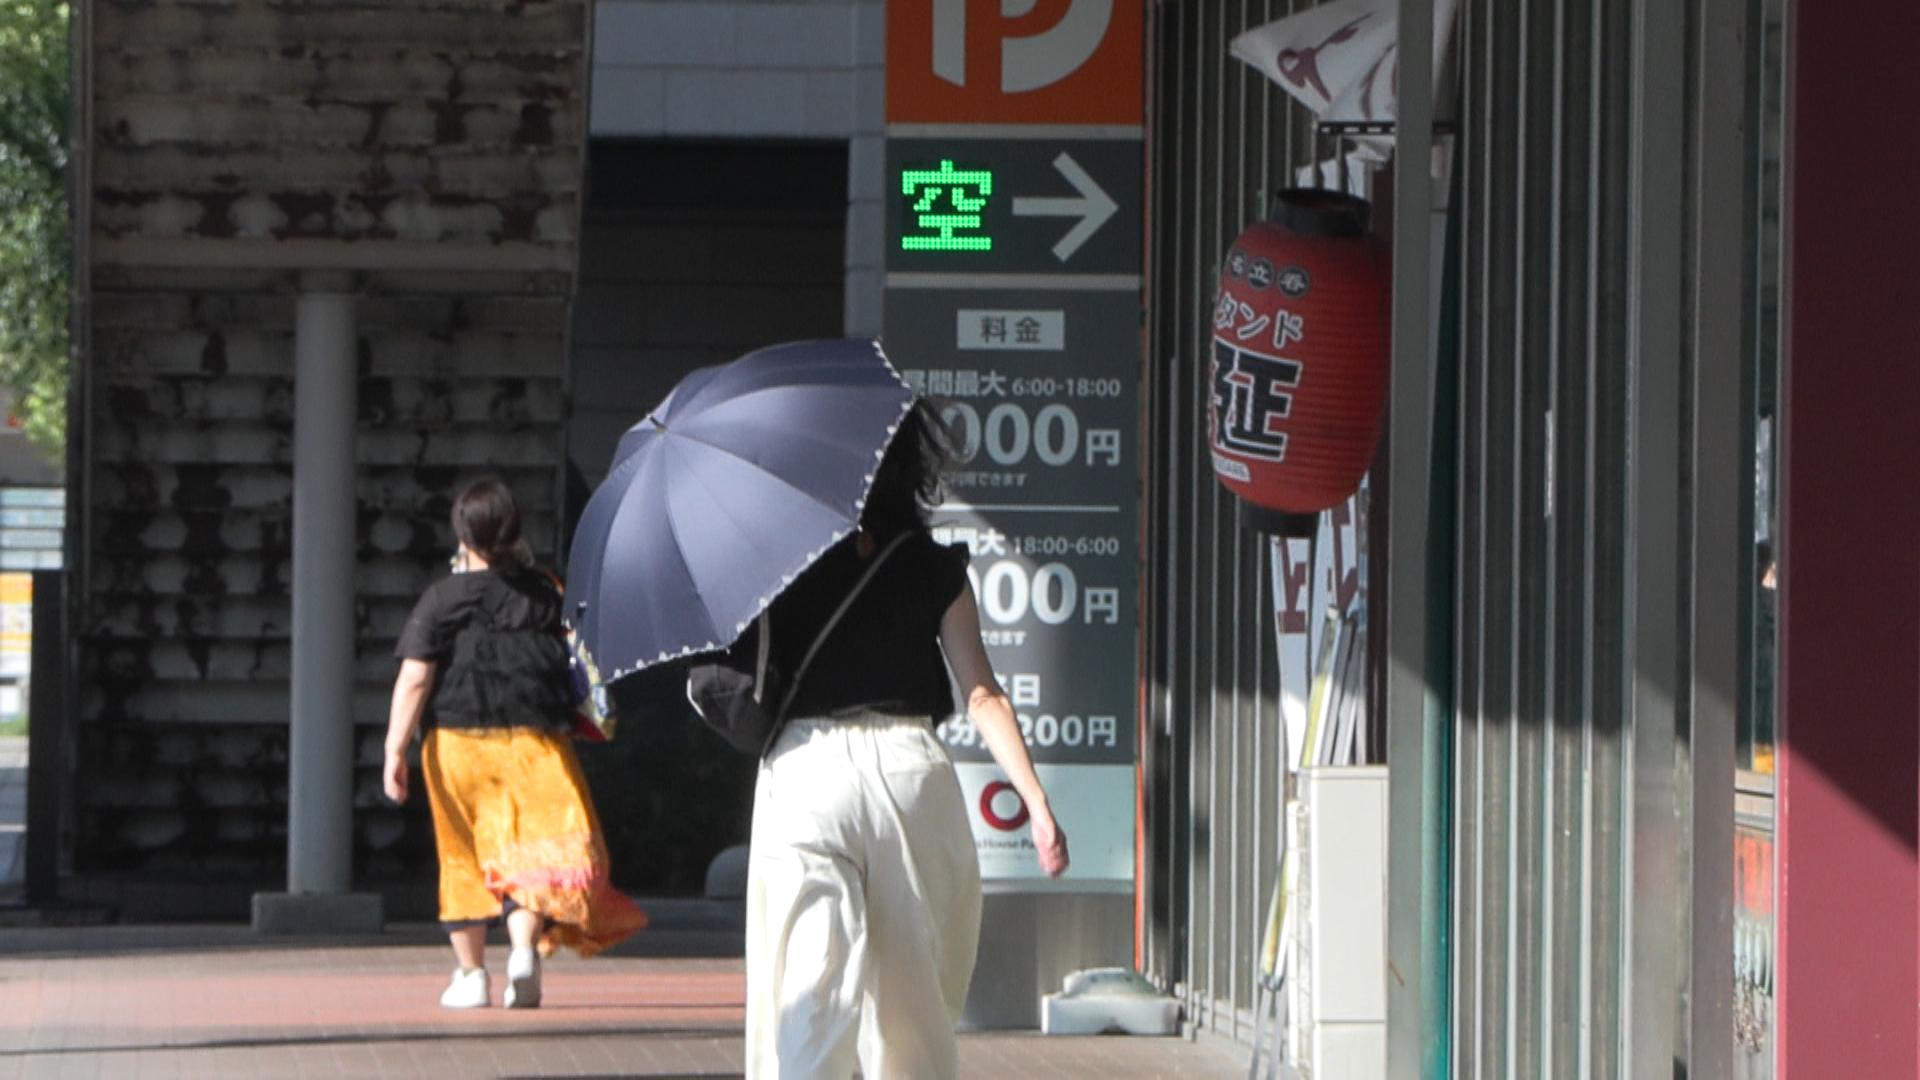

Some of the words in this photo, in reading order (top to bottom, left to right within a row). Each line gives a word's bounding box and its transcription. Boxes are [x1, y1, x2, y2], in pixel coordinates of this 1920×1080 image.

[902, 160, 992, 250] 空
[979, 316, 1041, 343] 料金
[1012, 378, 1121, 397] 6:00-18:00
[1013, 536, 1119, 555] 18:00-6:00
